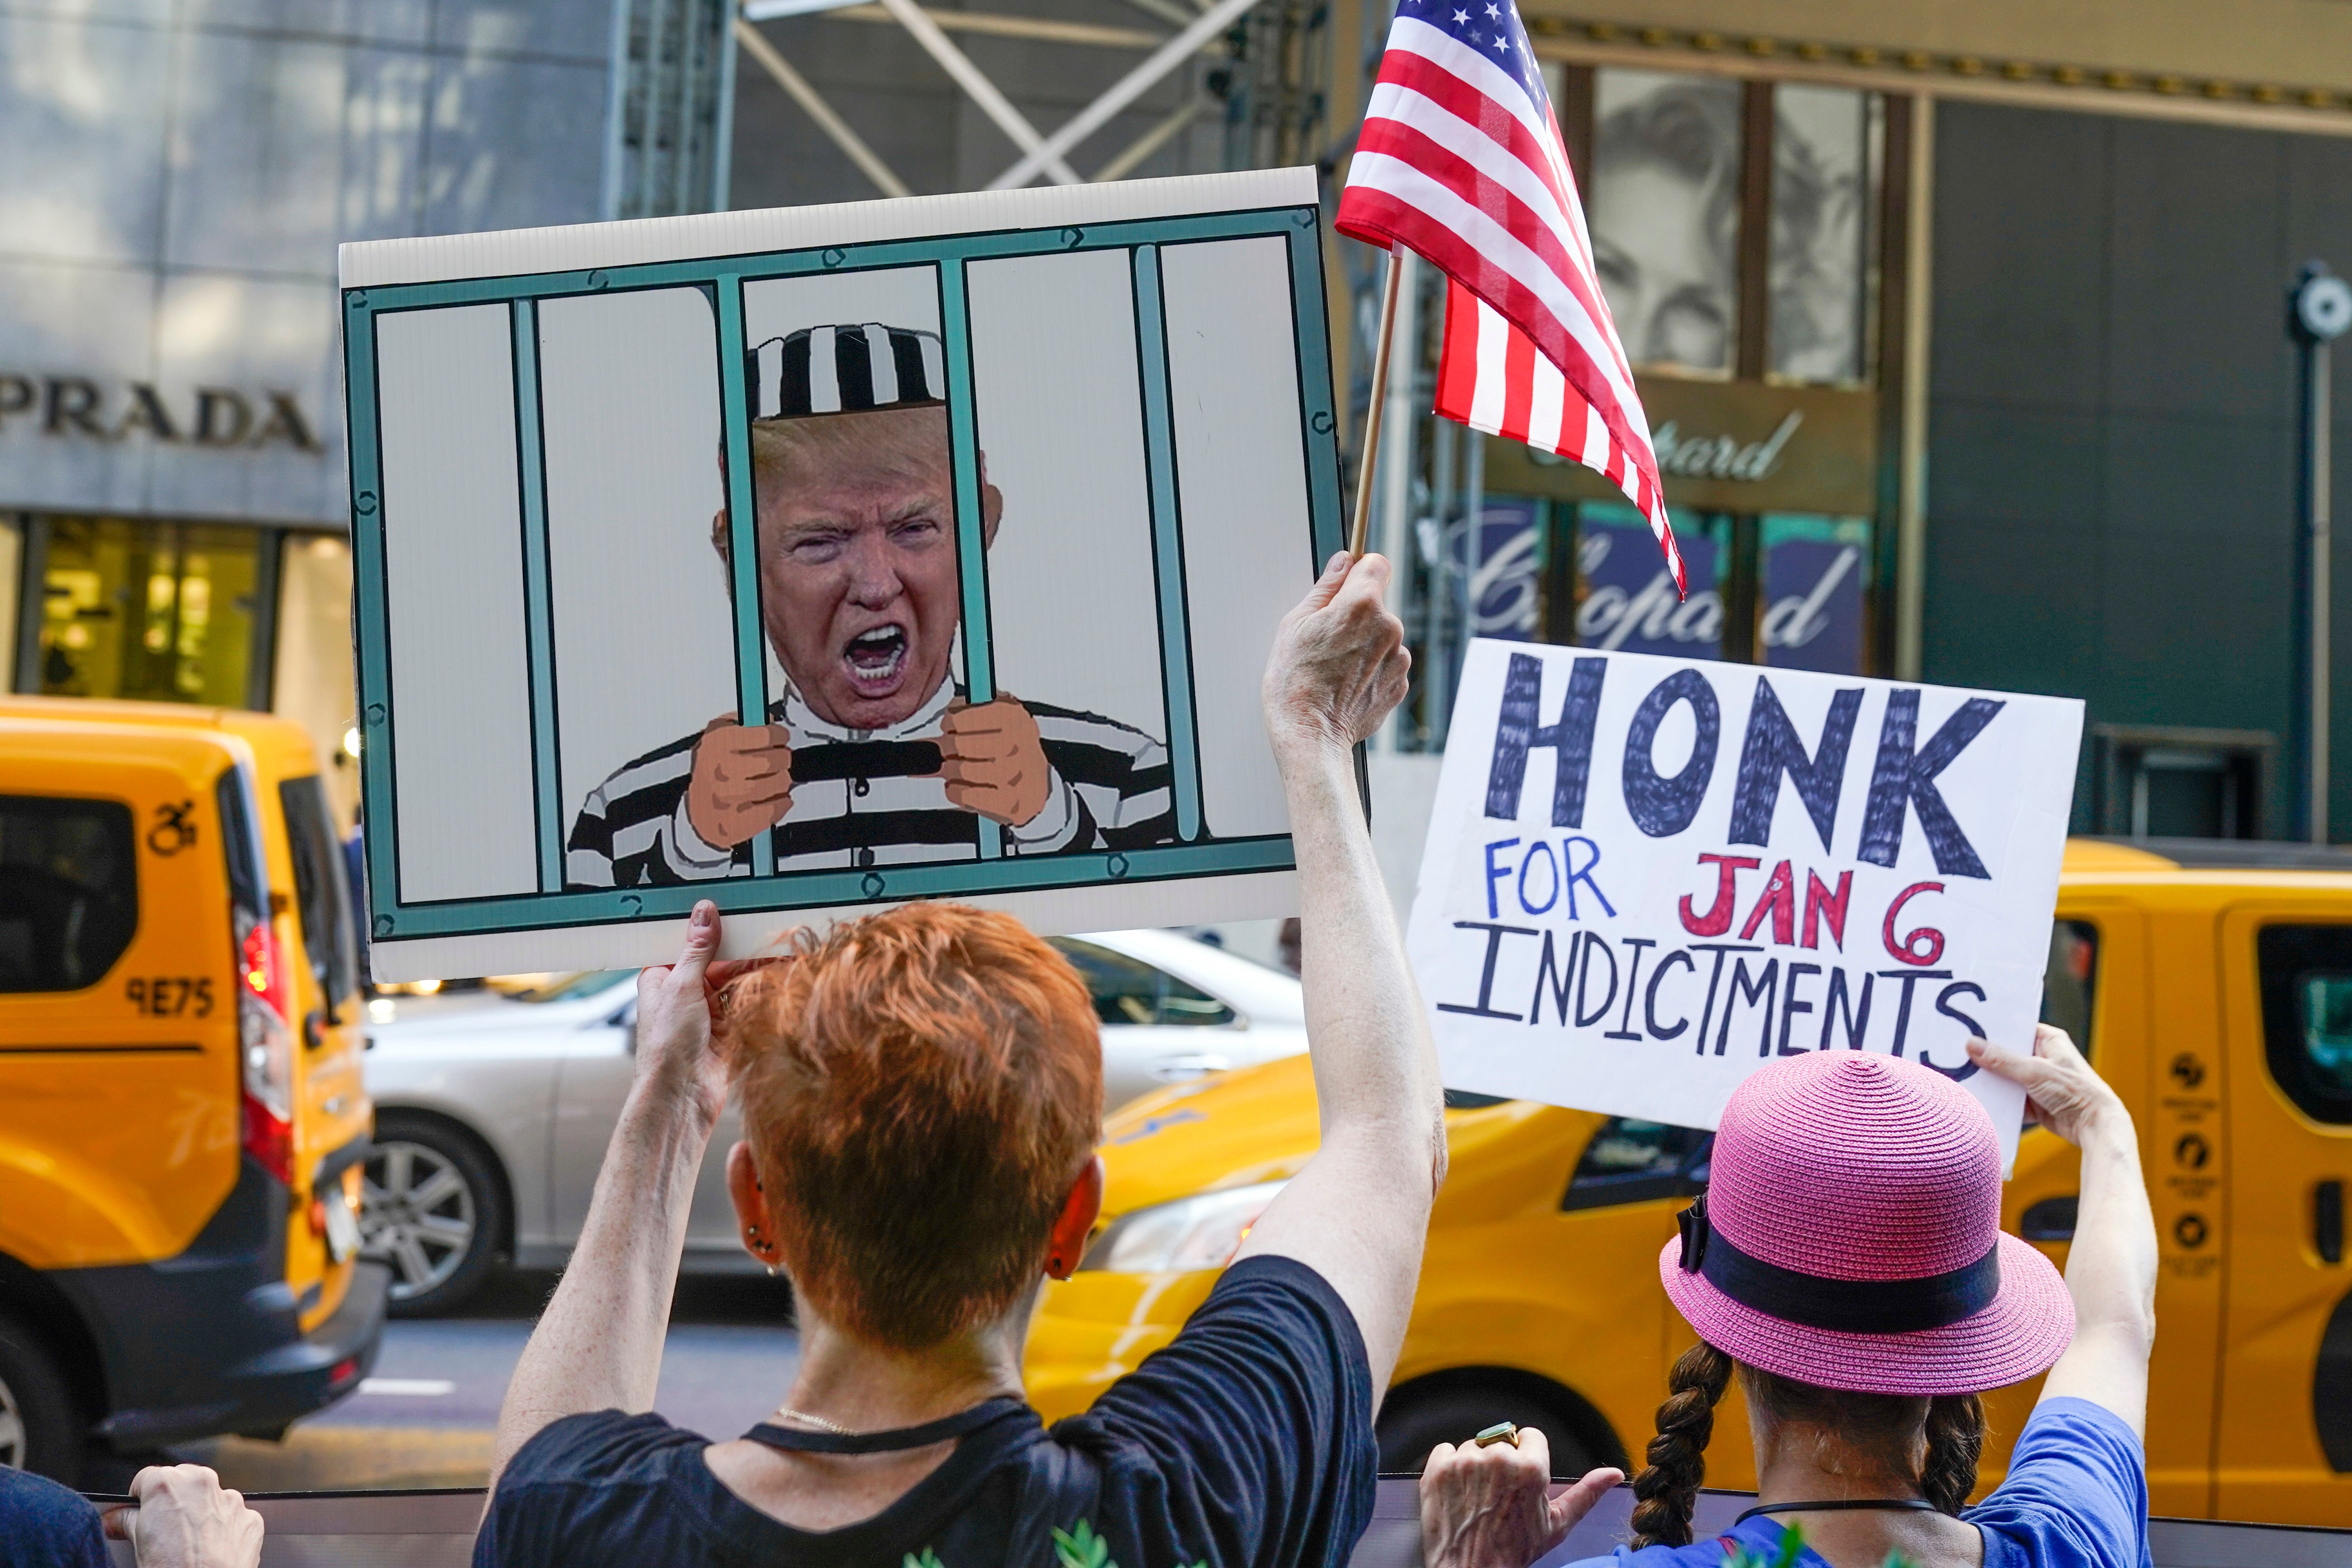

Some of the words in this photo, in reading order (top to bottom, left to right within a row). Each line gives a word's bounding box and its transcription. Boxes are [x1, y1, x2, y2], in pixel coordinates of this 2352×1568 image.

[0, 375, 328, 455] PRADA
[1439, 510, 1858, 650] Copad
[1484, 652, 2007, 880] HONK
[1484, 836, 1617, 920] FOR
[1679, 853, 1853, 951] JAN
[1882, 881, 1945, 967] 6
[126, 977, 215, 1018] 9E75
[1436, 920, 1987, 1082] INDICTMENTS
